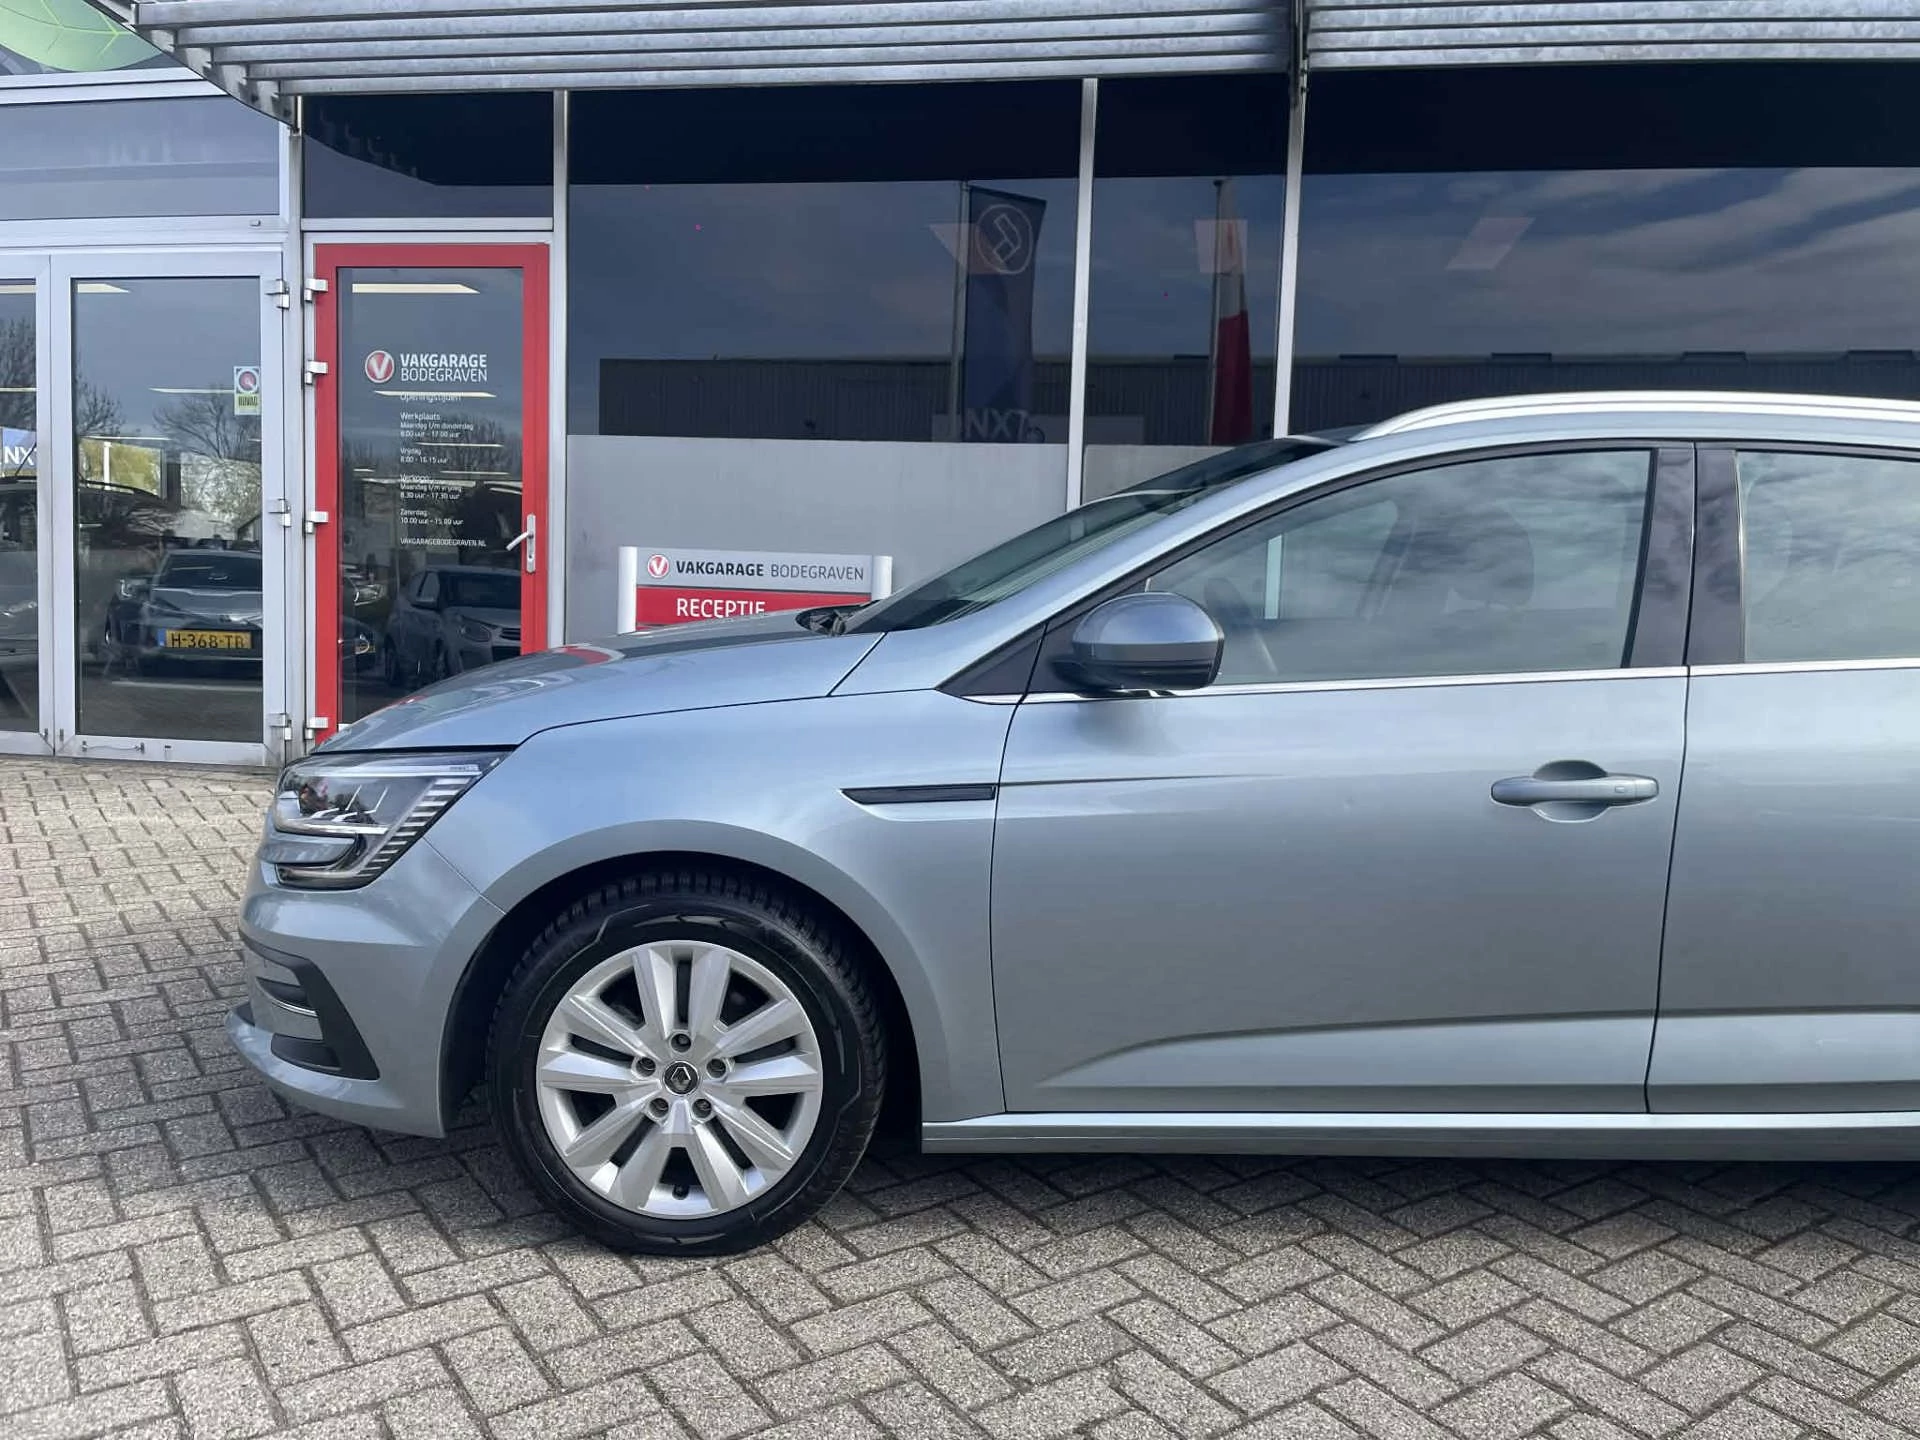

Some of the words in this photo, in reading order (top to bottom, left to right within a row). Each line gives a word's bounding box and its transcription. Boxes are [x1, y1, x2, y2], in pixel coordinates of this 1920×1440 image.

[400, 353, 487, 368] VAKGARAGE
[401, 367, 488, 382] BODEGRAVEN
[400, 412, 440, 422] Werkplaats
[400, 508, 428, 517] Zaterdag
[676, 560, 765, 577] VAKGARAGE
[770, 564, 864, 581] BODEGRAVEN
